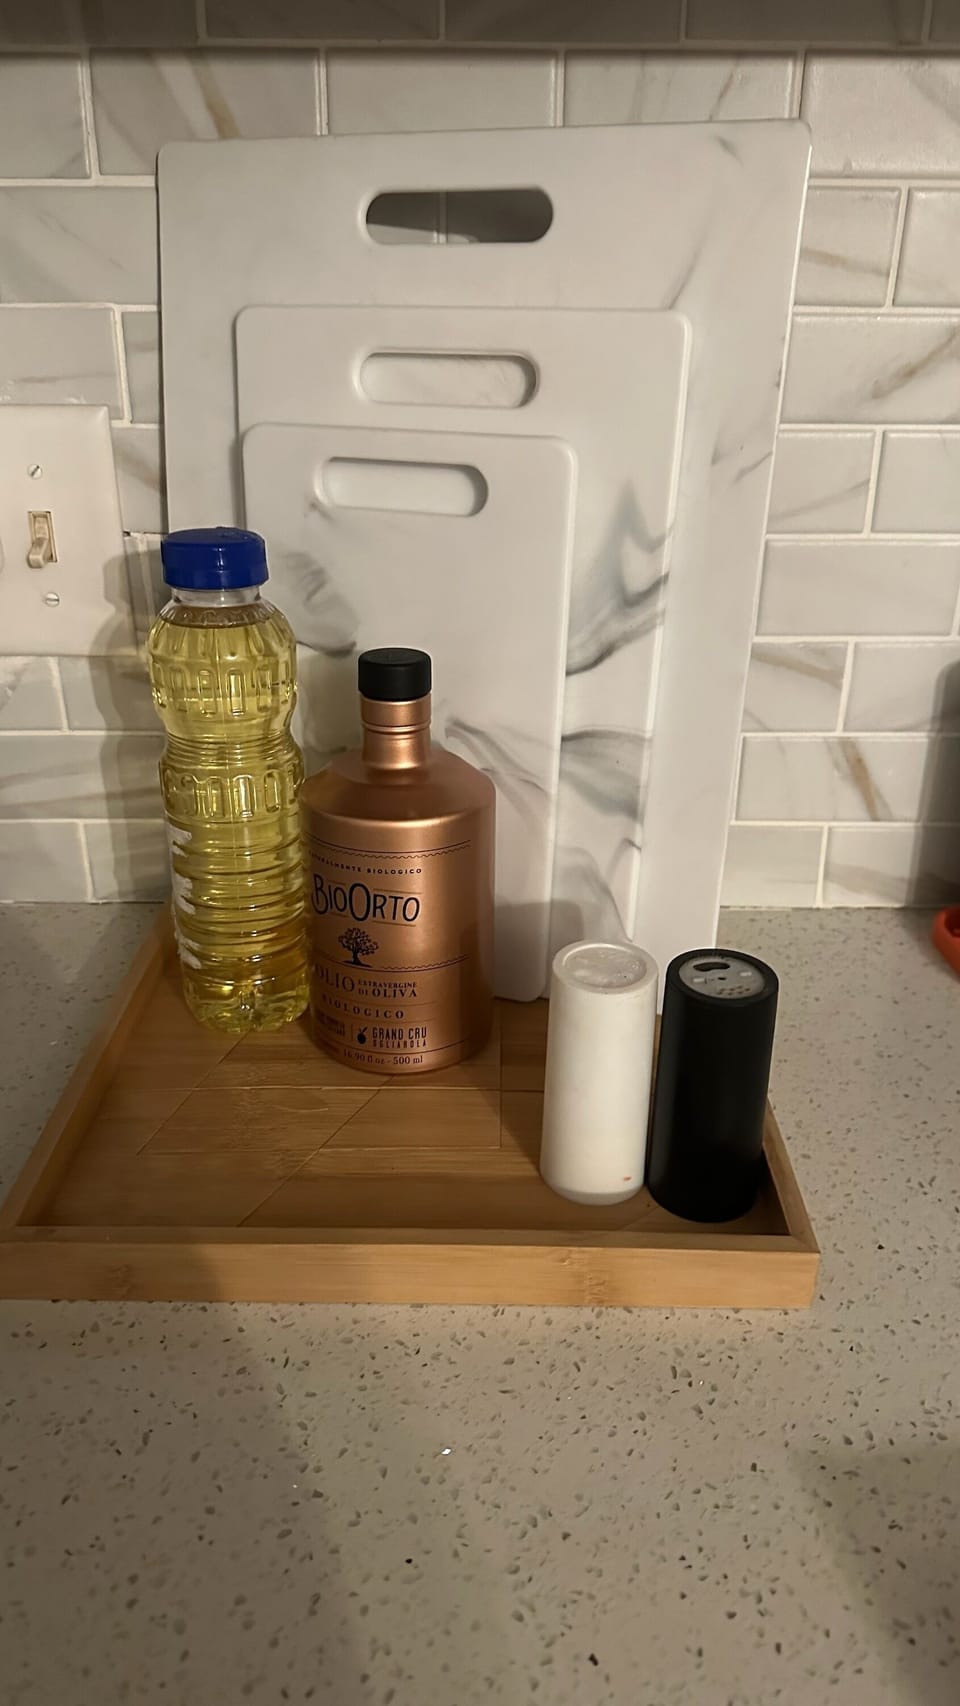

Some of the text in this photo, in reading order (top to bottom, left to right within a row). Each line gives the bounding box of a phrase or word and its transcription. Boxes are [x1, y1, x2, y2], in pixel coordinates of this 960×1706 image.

[315, 964, 355, 992] OLIO
[358, 979, 417, 989] EXTRAVERGINE
[372, 988, 417, 998] OLIVA
[321, 993, 404, 1019] BIOLOGICO
[372, 1026, 427, 1041] GRAND CRU
[393, 1056, 410, 1065] 500
[413, 1055, 423, 1064] ml
